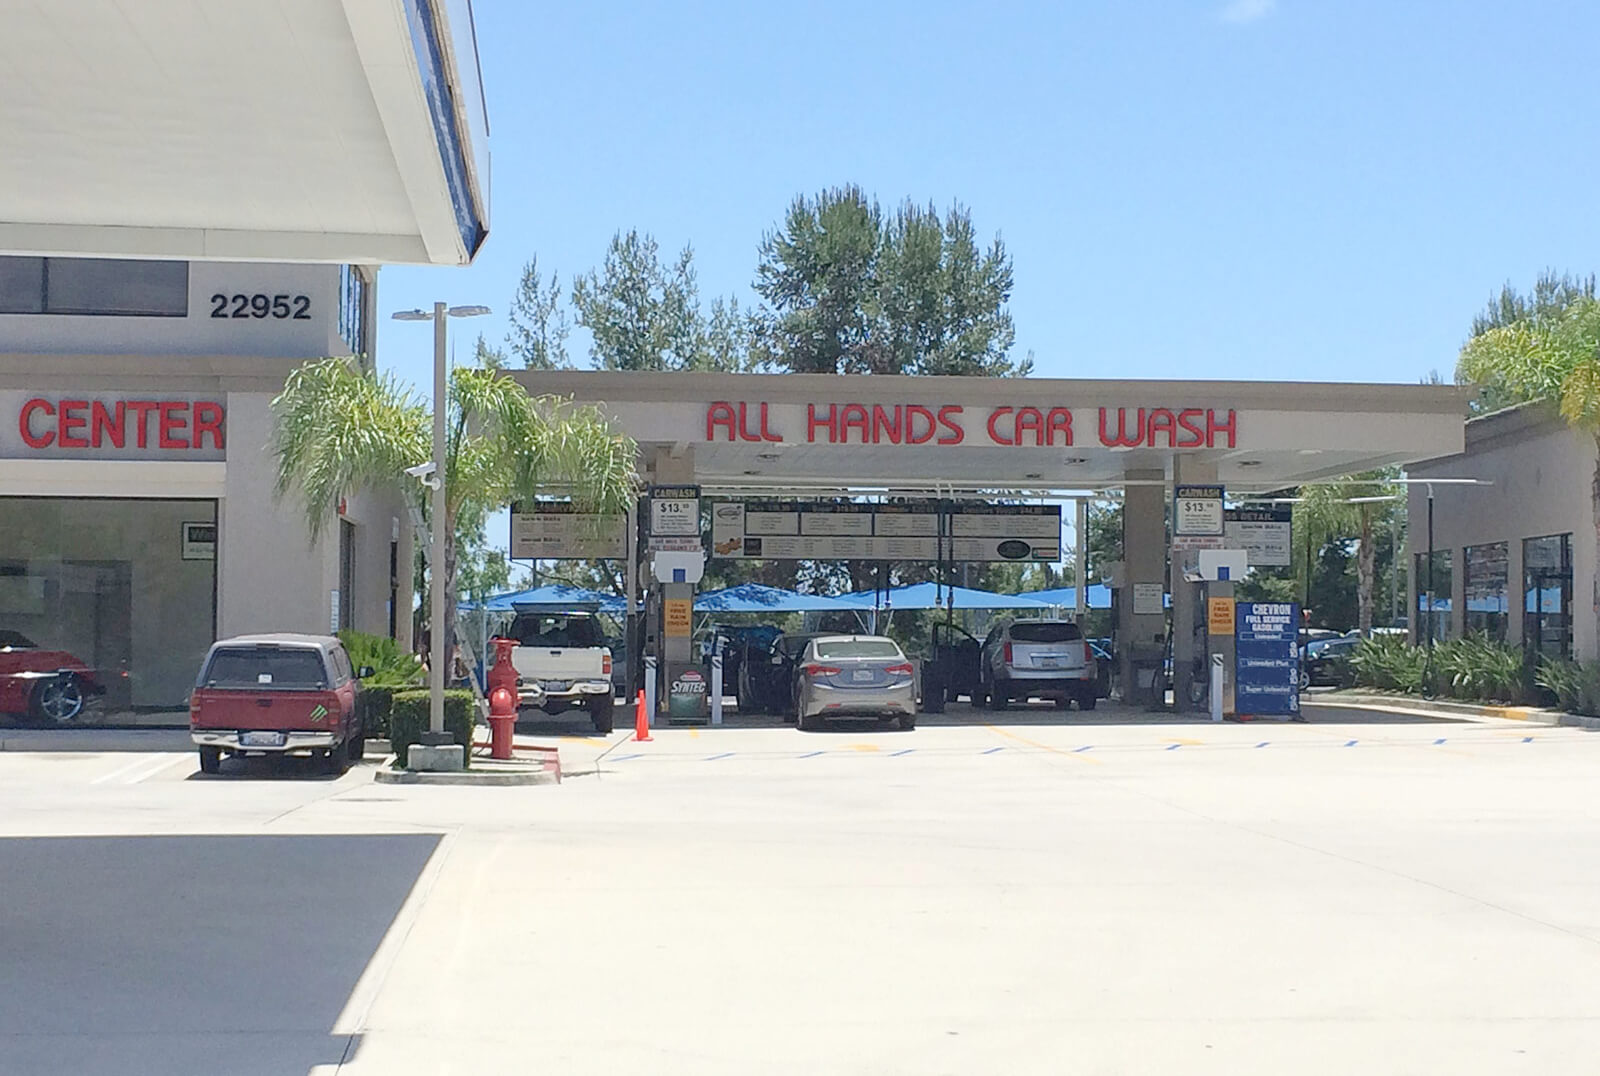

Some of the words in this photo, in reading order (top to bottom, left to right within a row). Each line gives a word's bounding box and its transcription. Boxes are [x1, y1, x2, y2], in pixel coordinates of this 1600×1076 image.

[210, 293, 311, 320] 22952
[19, 398, 226, 450] CENTER
[706, 401, 783, 443] ALL
[807, 403, 966, 446] HANDS
[986, 406, 1075, 448] CAR
[1099, 408, 1237, 450] WASH
[1252, 603, 1291, 615] CHEVRON
[1245, 615, 1262, 624] FULL
[670, 680, 706, 693] SYNTEC
